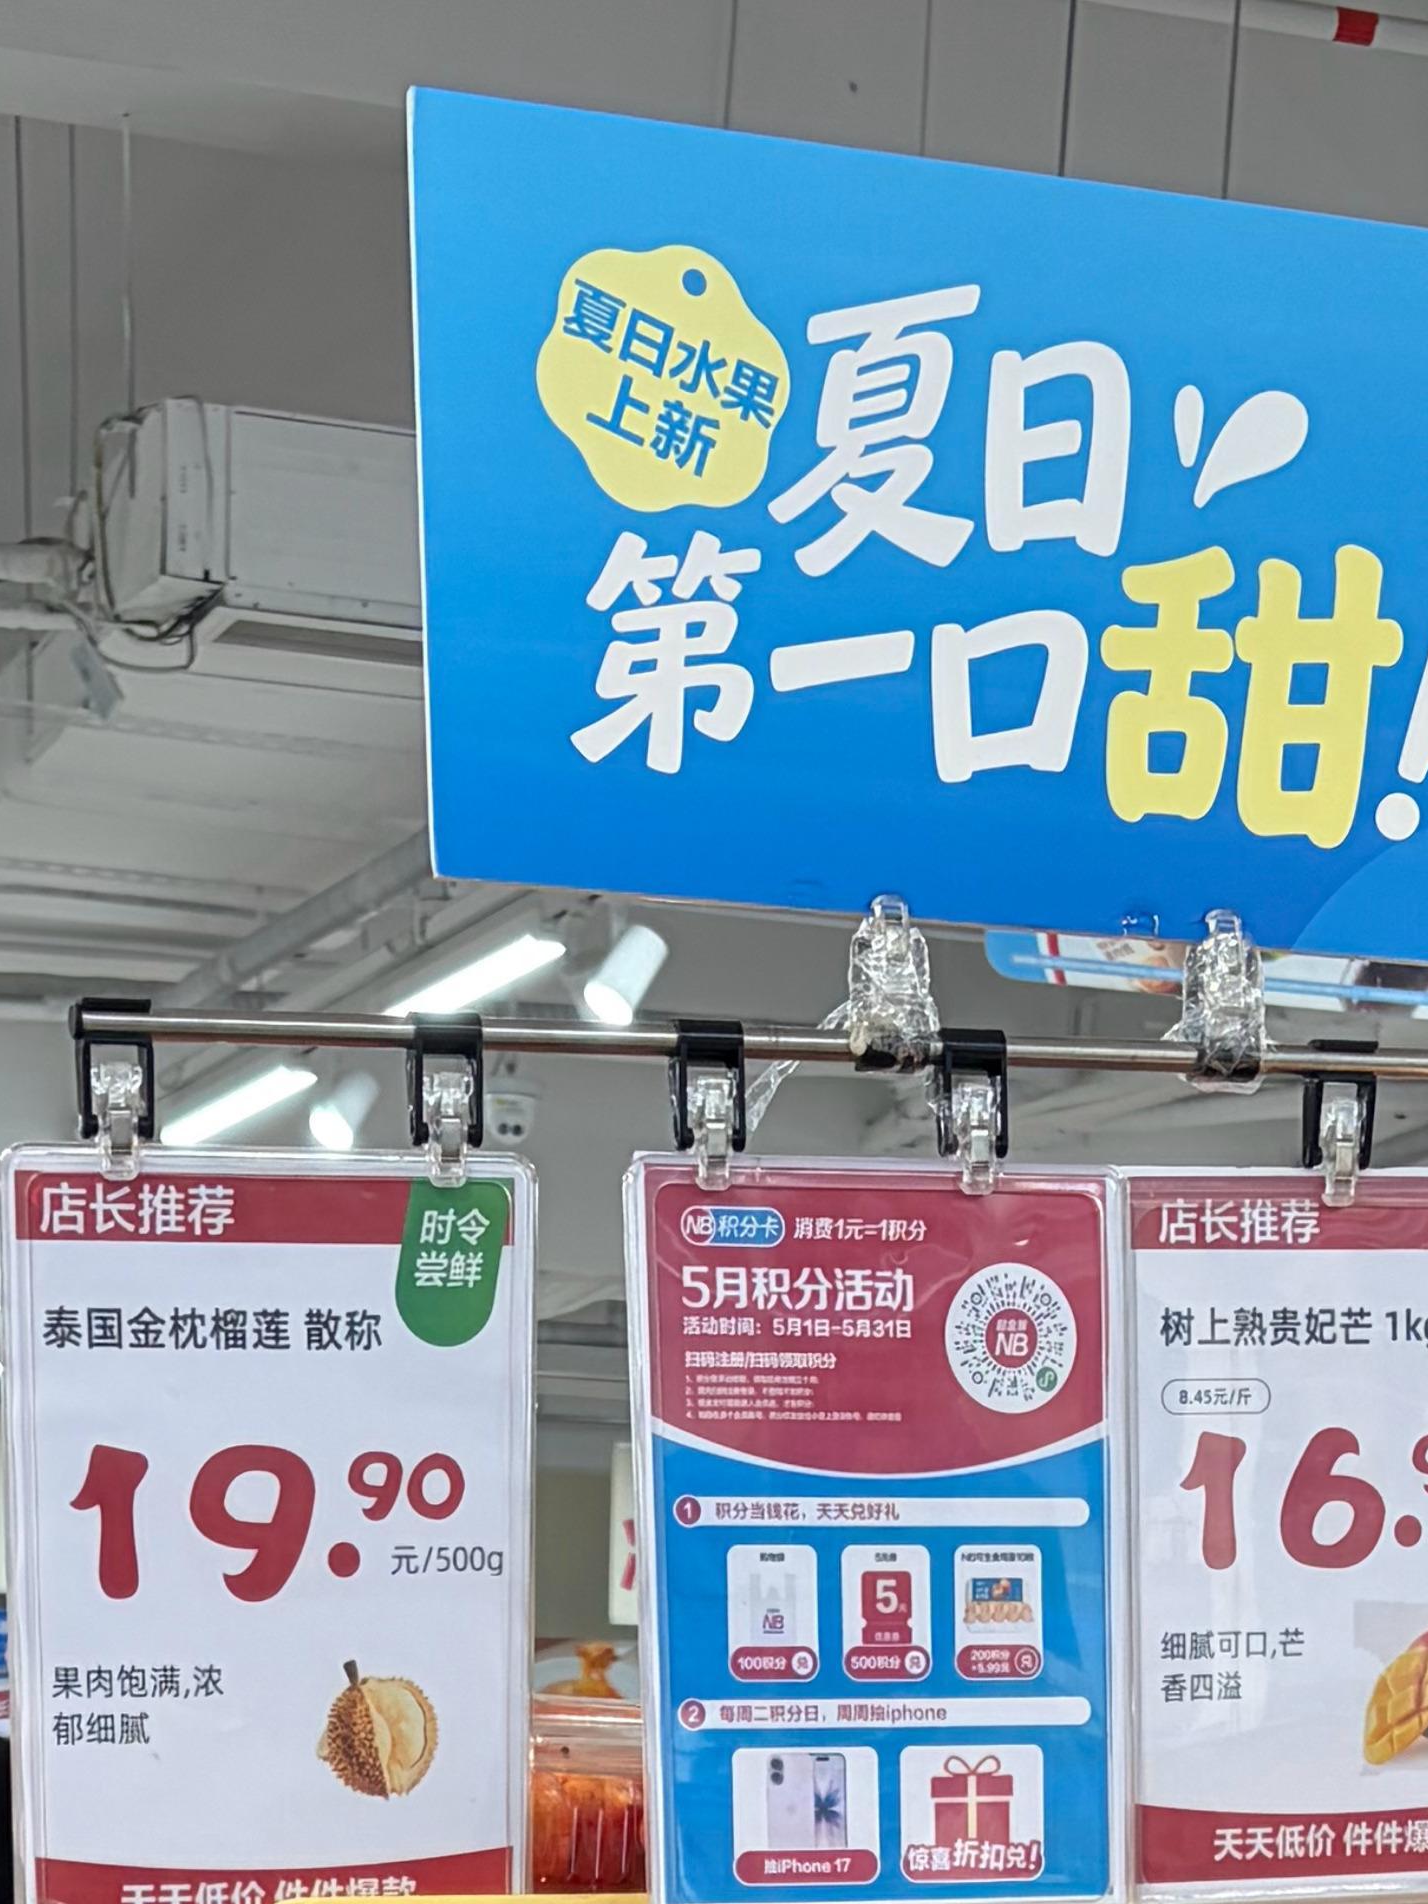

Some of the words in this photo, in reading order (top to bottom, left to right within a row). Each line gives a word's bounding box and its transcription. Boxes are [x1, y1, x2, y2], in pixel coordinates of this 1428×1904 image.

[563, 278, 781, 427] 夏日水果
[586, 374, 719, 478] 上新
[768, 285, 1129, 576] 夏日
[39, 1184, 236, 1236] 店长推荐
[420, 1207, 491, 1245] 时令
[717, 1215, 780, 1240] 积分卡
[1159, 1198, 1321, 1244] 店长推荐
[792, 1217, 928, 1242] 消费1元=1积分
[414, 1250, 485, 1288] 尝鲜
[681, 1264, 915, 1313] 5月积分活动
[42, 1306, 292, 1350] 泰国金枕榴莲
[303, 1309, 383, 1351] 散称
[995, 1332, 1029, 1357] NB
[1159, 1306, 1373, 1347] 树上熟贵妃芒
[1178, 1387, 1252, 1407] 8.45元/斤
[390, 1545, 504, 1576] 元/500g
[1159, 1628, 1305, 1661] 细腻可口,芒
[51, 1663, 225, 1700] 果肉饱满,浓
[1160, 1671, 1243, 1702] 香四溢
[51, 1712, 150, 1746] 郁细腻
[1213, 1823, 1335, 1861] 天天低价
